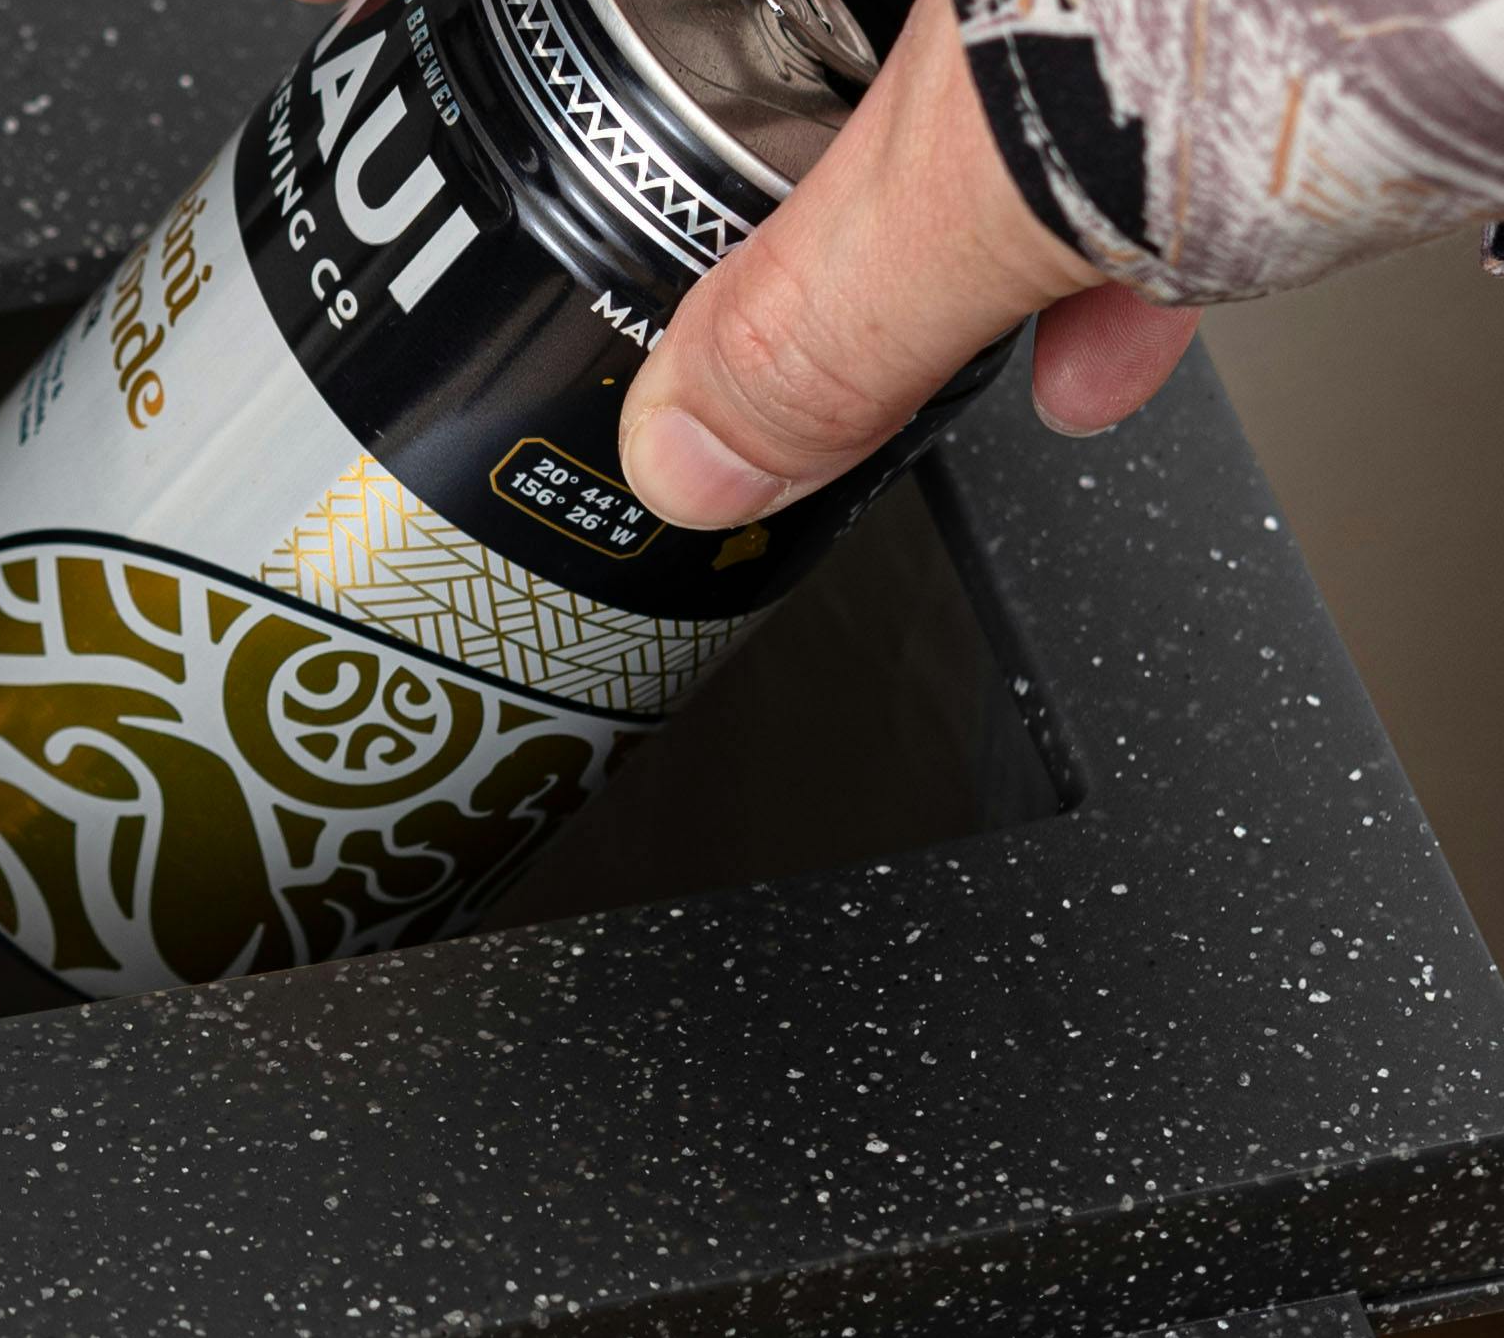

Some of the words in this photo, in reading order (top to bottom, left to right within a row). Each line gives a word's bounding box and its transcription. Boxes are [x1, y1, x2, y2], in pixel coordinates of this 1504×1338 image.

[407, 6, 461, 127] BREWED
[268, 64, 317, 252] EWING
[609, 525, 638, 546] W
[620, 506, 644, 524] N
